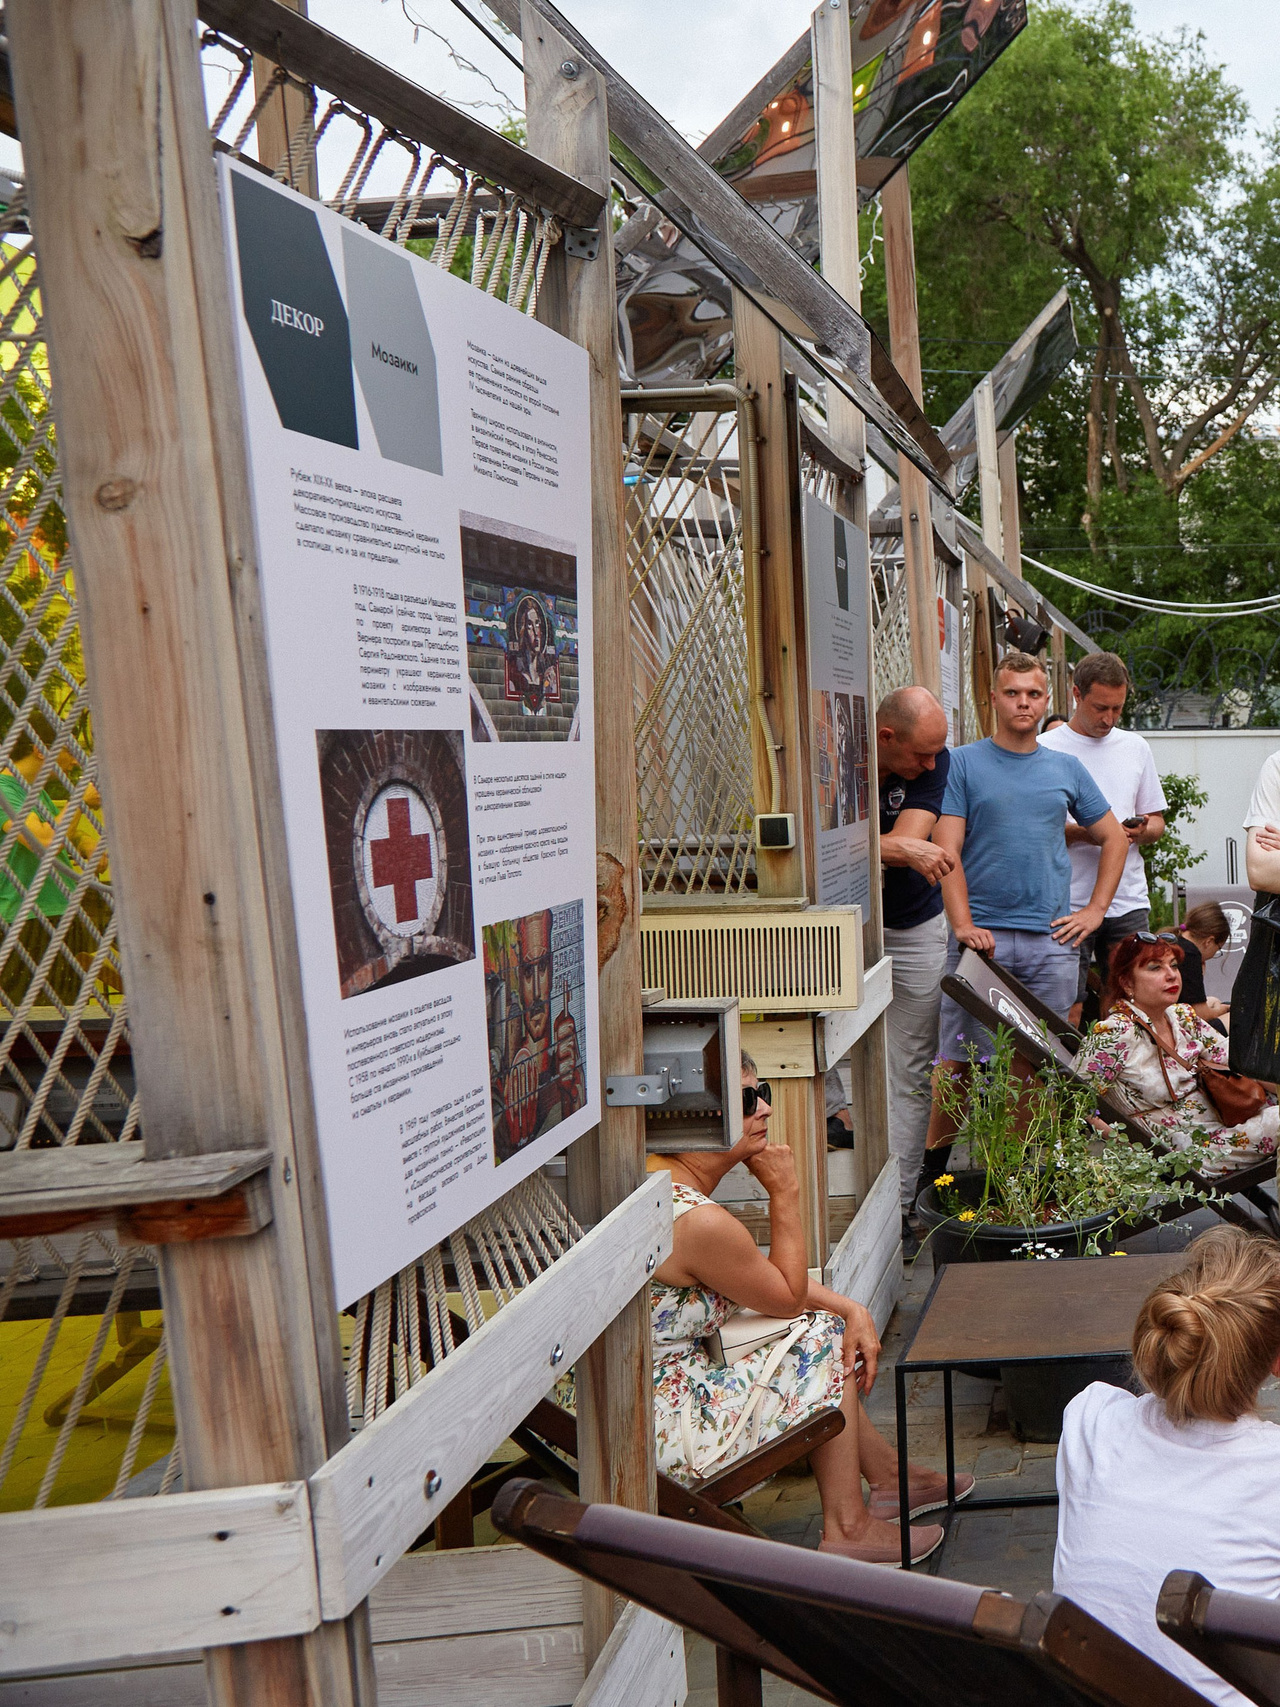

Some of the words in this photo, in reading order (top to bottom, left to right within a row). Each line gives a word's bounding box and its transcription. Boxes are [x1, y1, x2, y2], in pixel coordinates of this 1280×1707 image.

[271, 299, 325, 337] ДЕКОР
[371, 341, 419, 376] Мозаики
[290, 467, 311, 482] Рубеж
[335, 482, 351, 493] веков
[360, 489, 376, 499] эпоха
[377, 493, 402, 506] расцвета
[293, 501, 326, 518] Массовое
[328, 512, 369, 528] производство
[370, 522, 414, 538] художественной
[415, 532, 438, 543] керамики
[295, 521, 324, 534] сделало
[326, 528, 351, 541] мозаику
[352, 533, 391, 548] сравнительно
[393, 542, 420, 554] доступной
[429, 550, 445, 559] только
[335, 546, 343, 554] но
[351, 549, 357, 557] за
[367, 552, 400, 565] пределами.
[358, 584, 384, 597] 1916-1918
[385, 591, 399, 601] годах
[404, 594, 427, 606] разъезде
[428, 596, 456, 609] Иващенково
[354, 603, 365, 613] под
[368, 602, 393, 616] Самарой
[417, 611, 432, 621] город
[434, 611, 457, 624] Чапаевск)
[372, 621, 393, 631] проекту
[401, 624, 430, 635] архитектора
[437, 626, 457, 638] Дмитрия
[357, 631, 381, 645] Вернера
[383, 637, 409, 647] построили
[411, 640, 423, 649] храм
[424, 639, 458, 651] Преподобного
[358, 648, 379, 660] Сергия
[380, 650, 418, 662] Радонежского.
[420, 653, 438, 664] Здание
[447, 658, 459, 667] всему
[360, 666, 390, 676] периметру
[396, 668, 421, 677] украшают
[427, 671, 460, 679] керамические
[361, 682, 385, 690] мозаики
[403, 682, 440, 693] изображением
[355, 1071, 368, 1083] 1958
